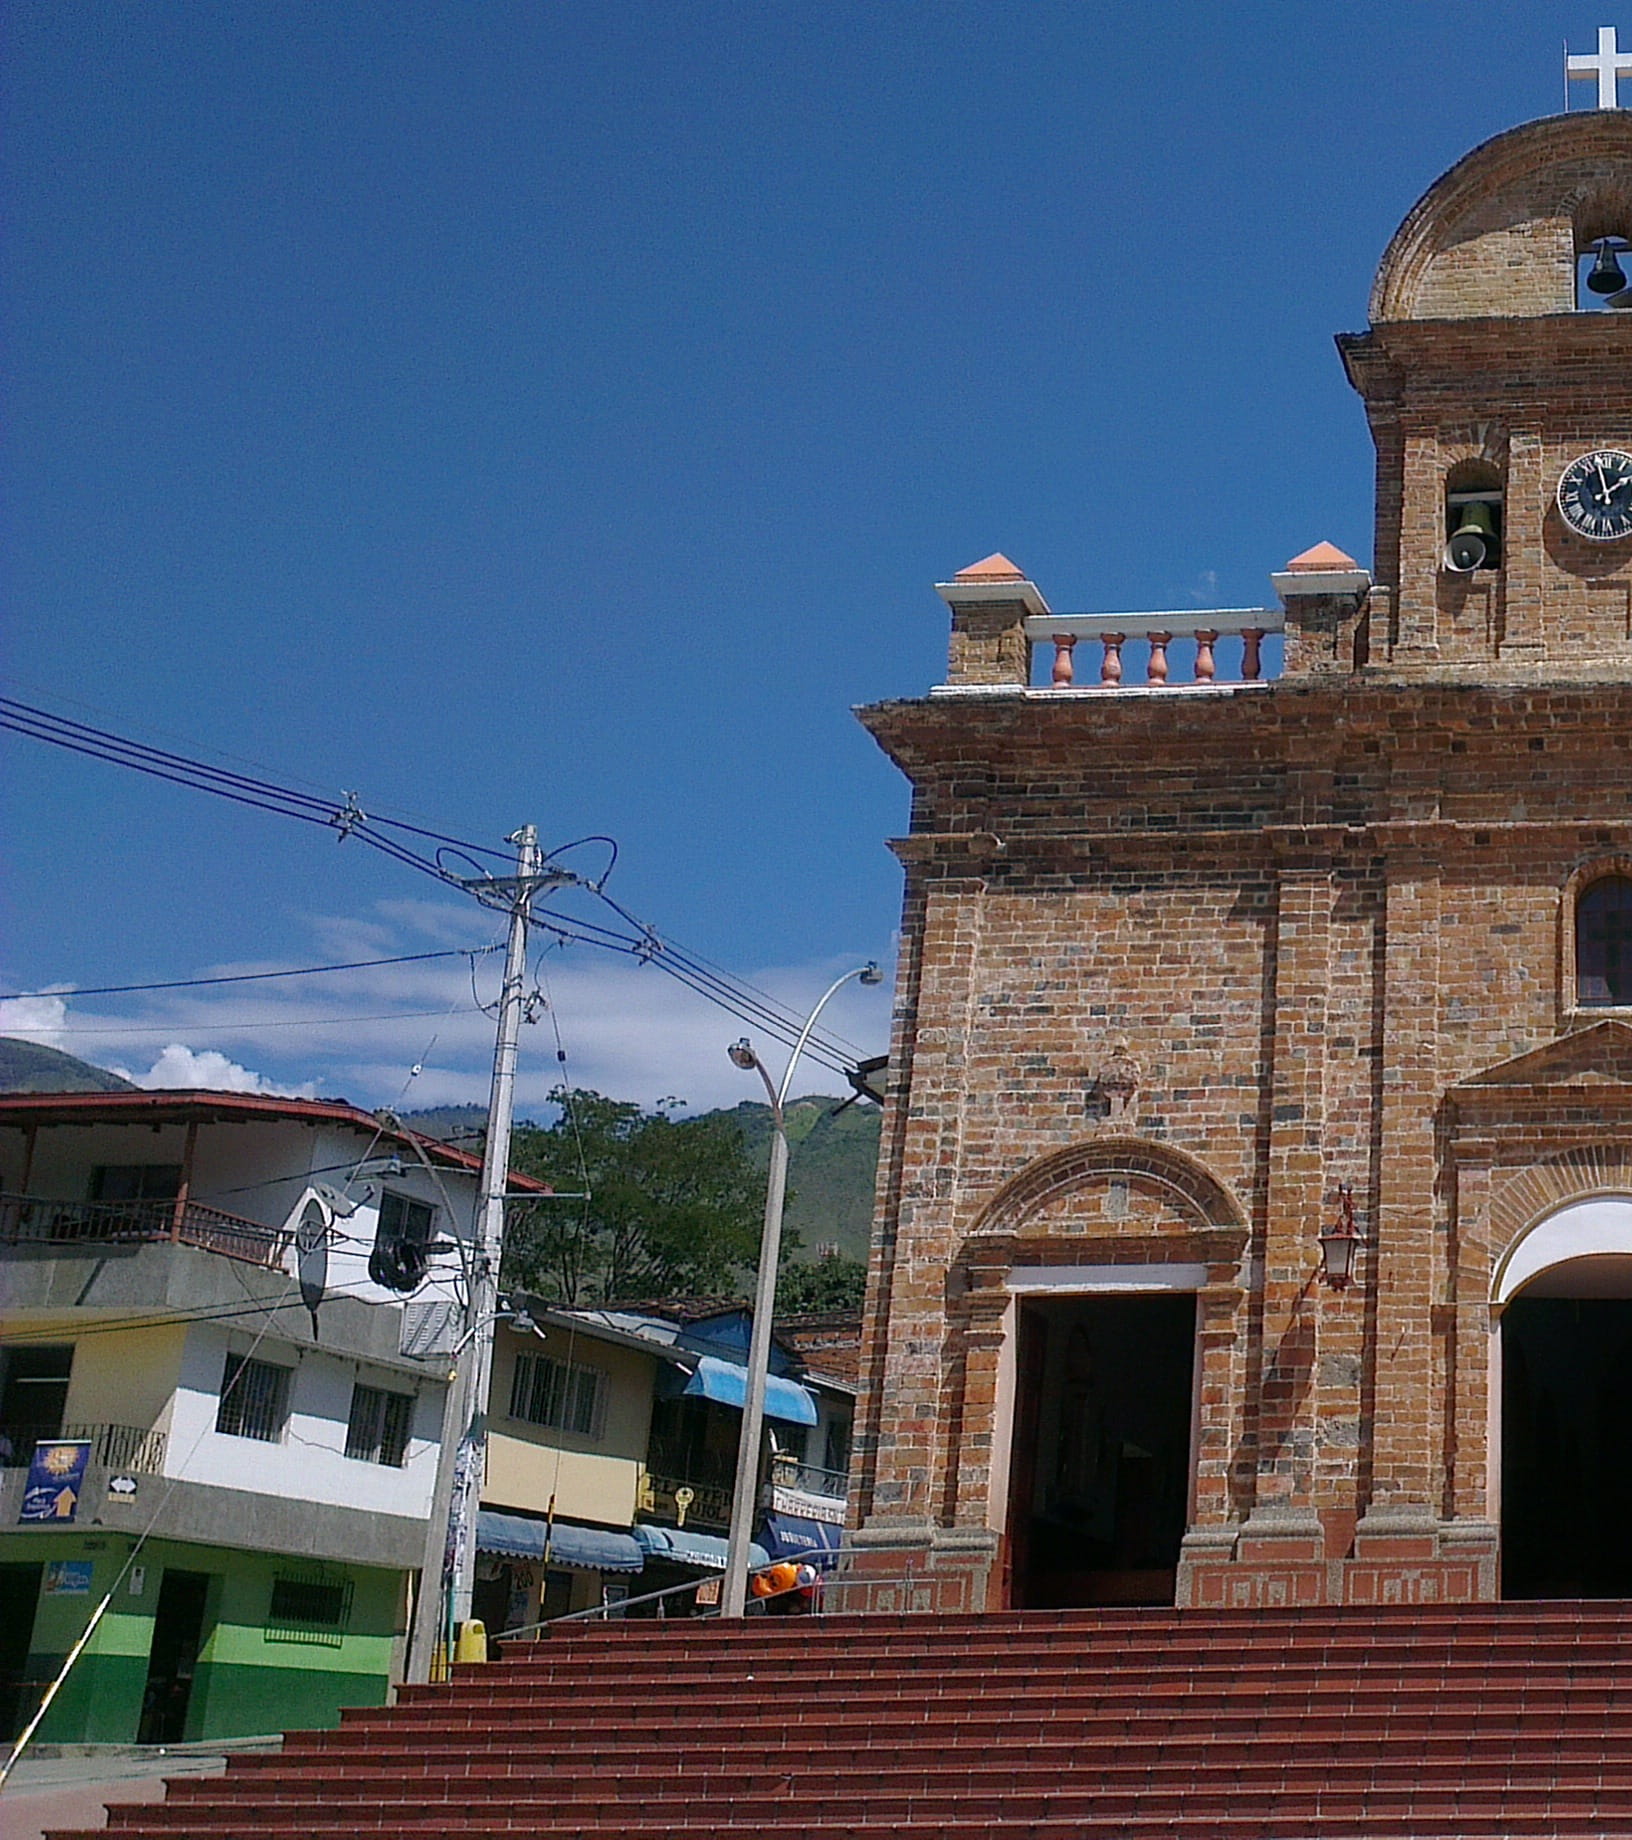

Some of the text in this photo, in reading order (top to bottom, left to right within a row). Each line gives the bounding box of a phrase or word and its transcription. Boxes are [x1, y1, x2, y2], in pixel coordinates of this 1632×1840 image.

[1579, 460, 1596, 476] XI
[1567, 475, 1583, 486] X
[1620, 514, 1631, 526] V
